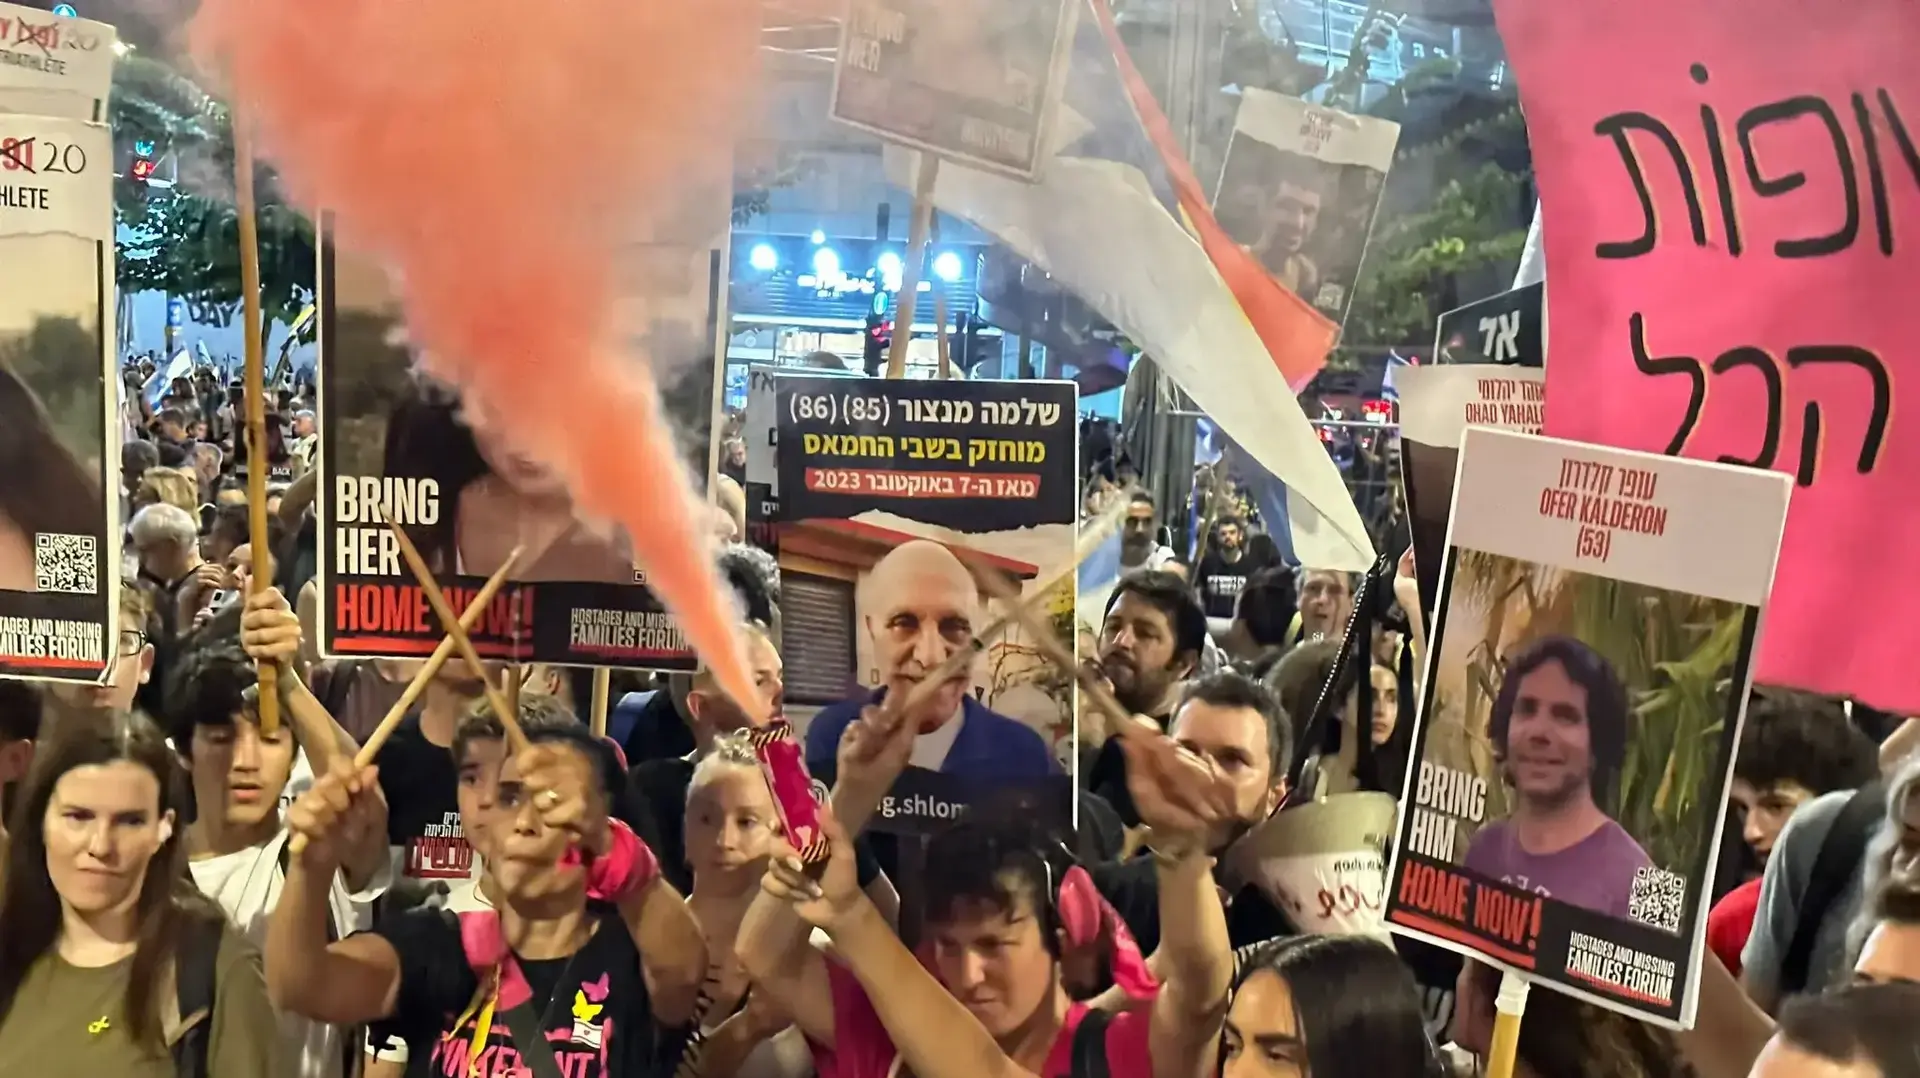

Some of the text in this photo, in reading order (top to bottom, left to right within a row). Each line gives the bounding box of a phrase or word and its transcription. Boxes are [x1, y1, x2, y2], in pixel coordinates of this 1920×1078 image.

[43, 142, 86, 174] 20
[789, 392, 1061, 426] שלמה מנצור (85) (86)
[1465, 402, 1498, 424] OHAD
[803, 433, 895, 457] החמאס
[901, 436, 963, 460] בשבי
[968, 438, 1046, 467] מוחזק
[814, 471, 860, 489] 2023
[865, 474, 955, 497] באוקטובר
[997, 477, 1035, 497] מאז
[1558, 458, 1658, 500] עופר קלדרון
[335, 474, 440, 525] BRING
[1539, 487, 1668, 537] OFER KALDERON
[335, 527, 402, 576] HER
[1576, 525, 1612, 563] (53)
[336, 583, 431, 632] HOME
[571, 608, 621, 626] HOSTAGES
[623, 611, 645, 628] AND
[31, 618, 54, 636] AND
[55, 620, 102, 640] MISSING
[570, 624, 636, 649] FAMILIES
[48, 636, 103, 662] FORUM
[1416, 759, 1488, 822] BRING
[1408, 807, 1458, 863] HIM
[1399, 858, 1472, 922] HOME
[1474, 884, 1543, 950] NOW!
[1570, 930, 1675, 978] HOSTAGES AND MISSING
[1566, 946, 1674, 1001] FAMILIES FORUM
